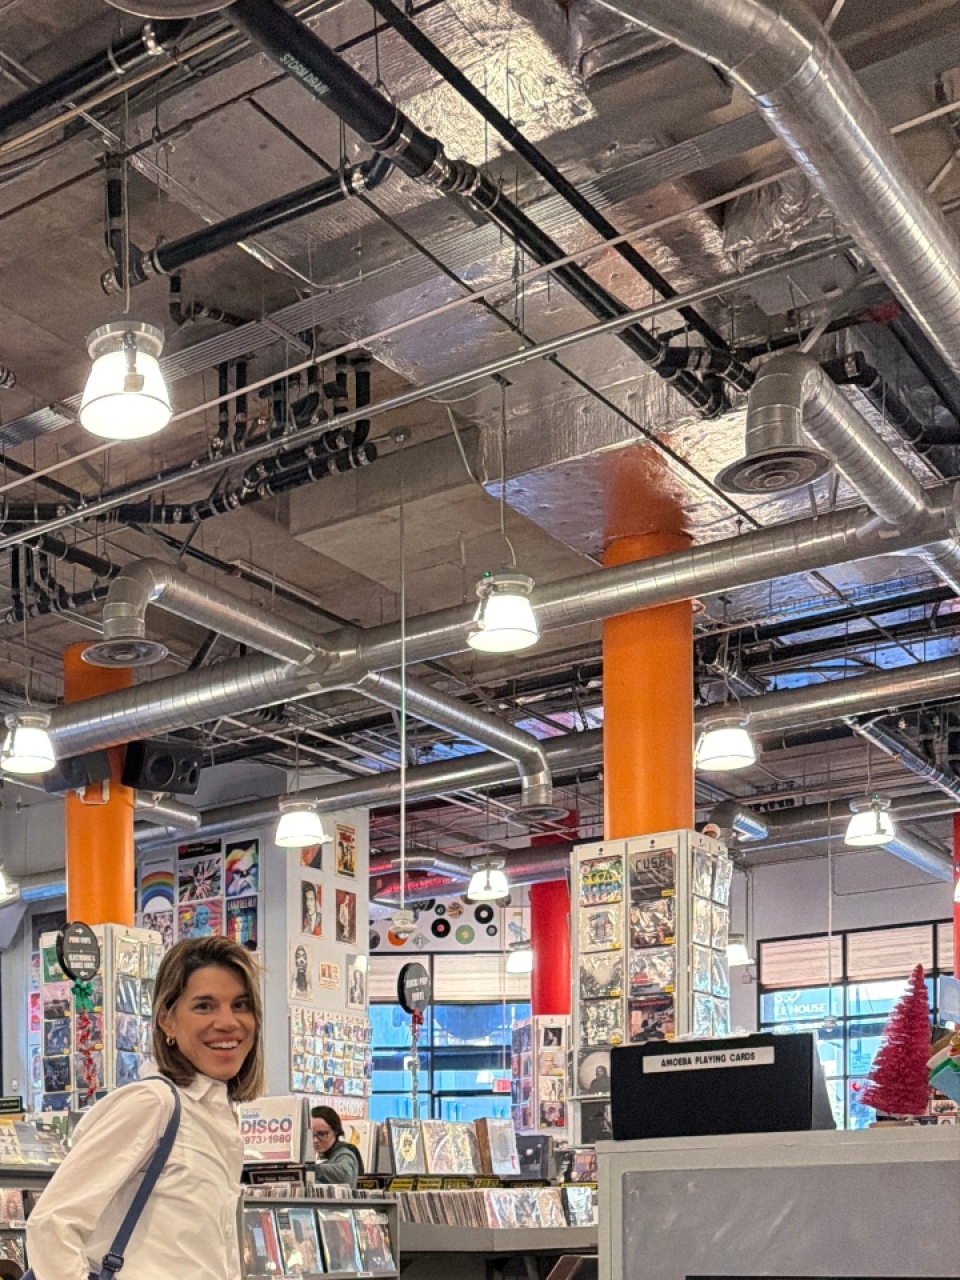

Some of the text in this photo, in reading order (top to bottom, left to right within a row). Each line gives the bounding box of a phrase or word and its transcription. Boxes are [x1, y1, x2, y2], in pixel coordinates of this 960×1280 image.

[790, 1003, 826, 1014] HOUSE
[660, 1051, 756, 1068] AMOEBA PLAYING CARDS
[241, 1118, 292, 1134] DISCO
